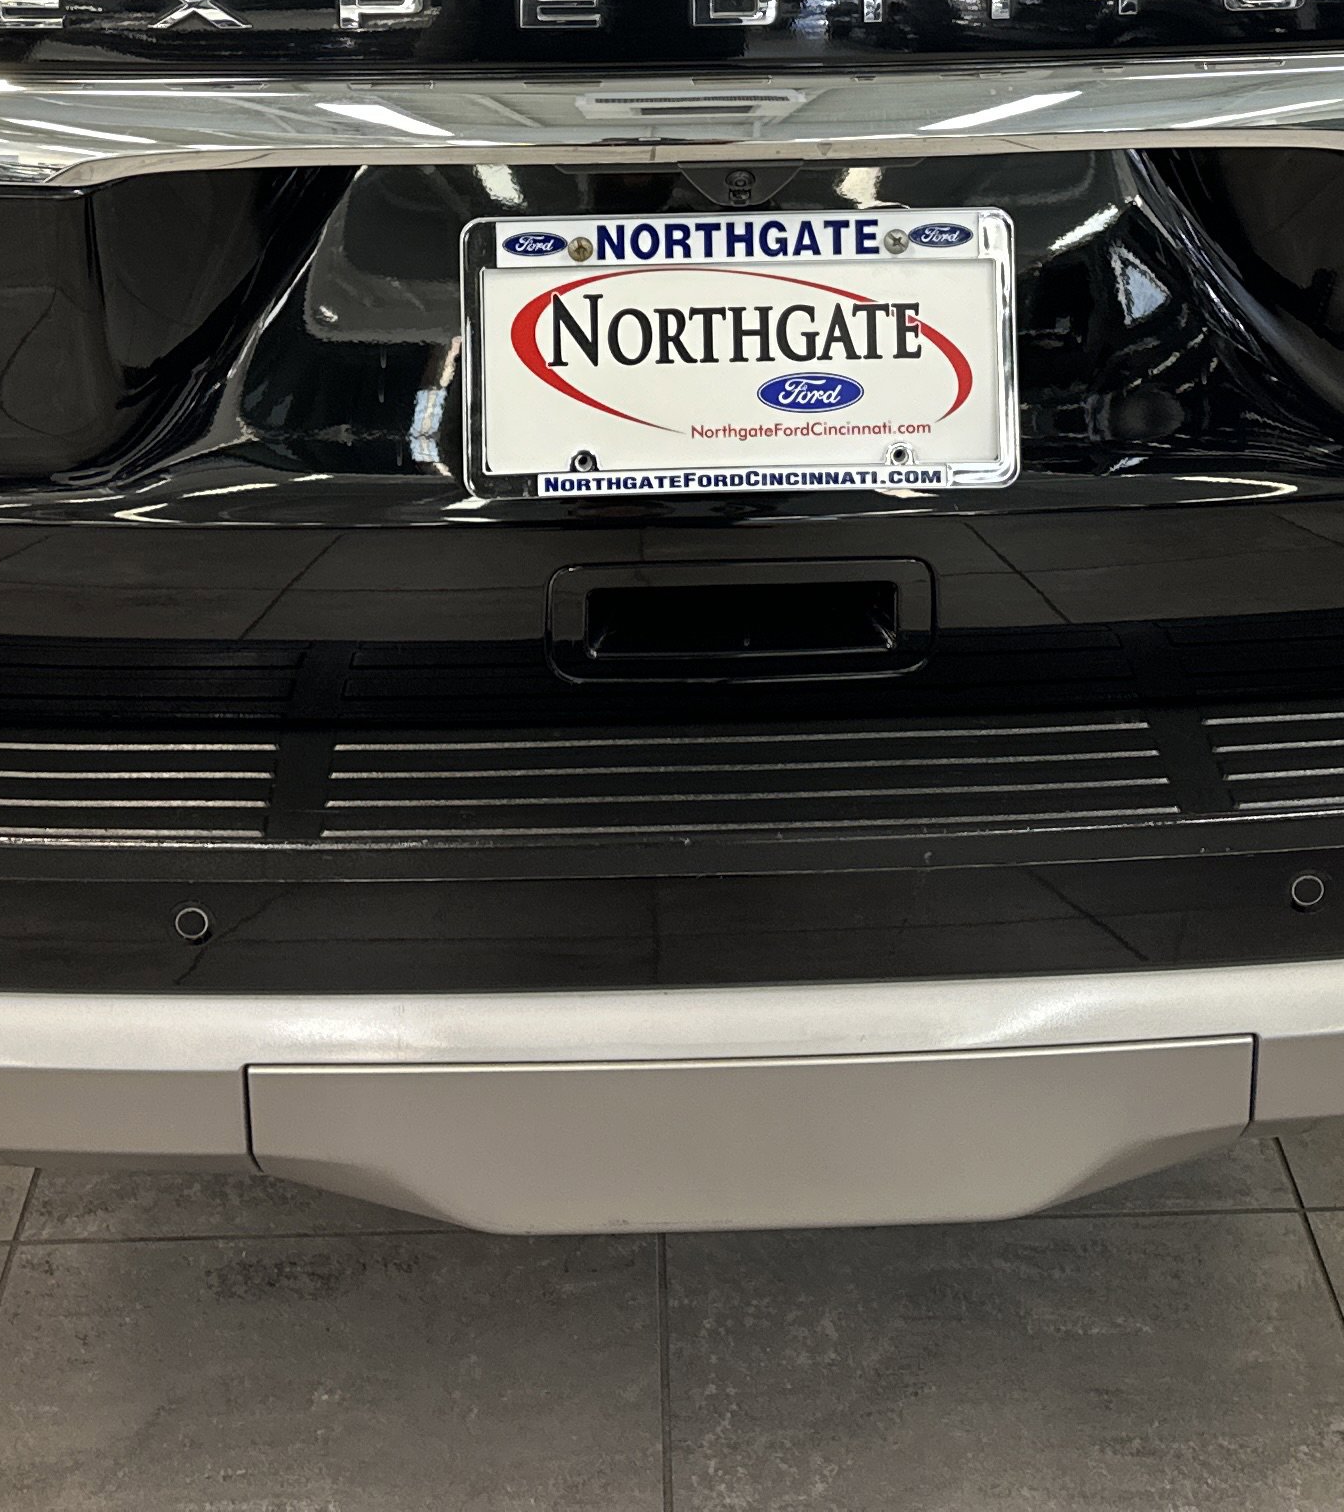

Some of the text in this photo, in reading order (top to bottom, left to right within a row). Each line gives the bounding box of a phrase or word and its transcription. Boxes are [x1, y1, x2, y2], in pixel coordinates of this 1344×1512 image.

[515, 219, 960, 261] Ford NORTHGATE Ford
[547, 293, 922, 367] NORTHGATE
[778, 377, 842, 406] Ford
[691, 420, 932, 441] NorthgateFordCincinnati.com
